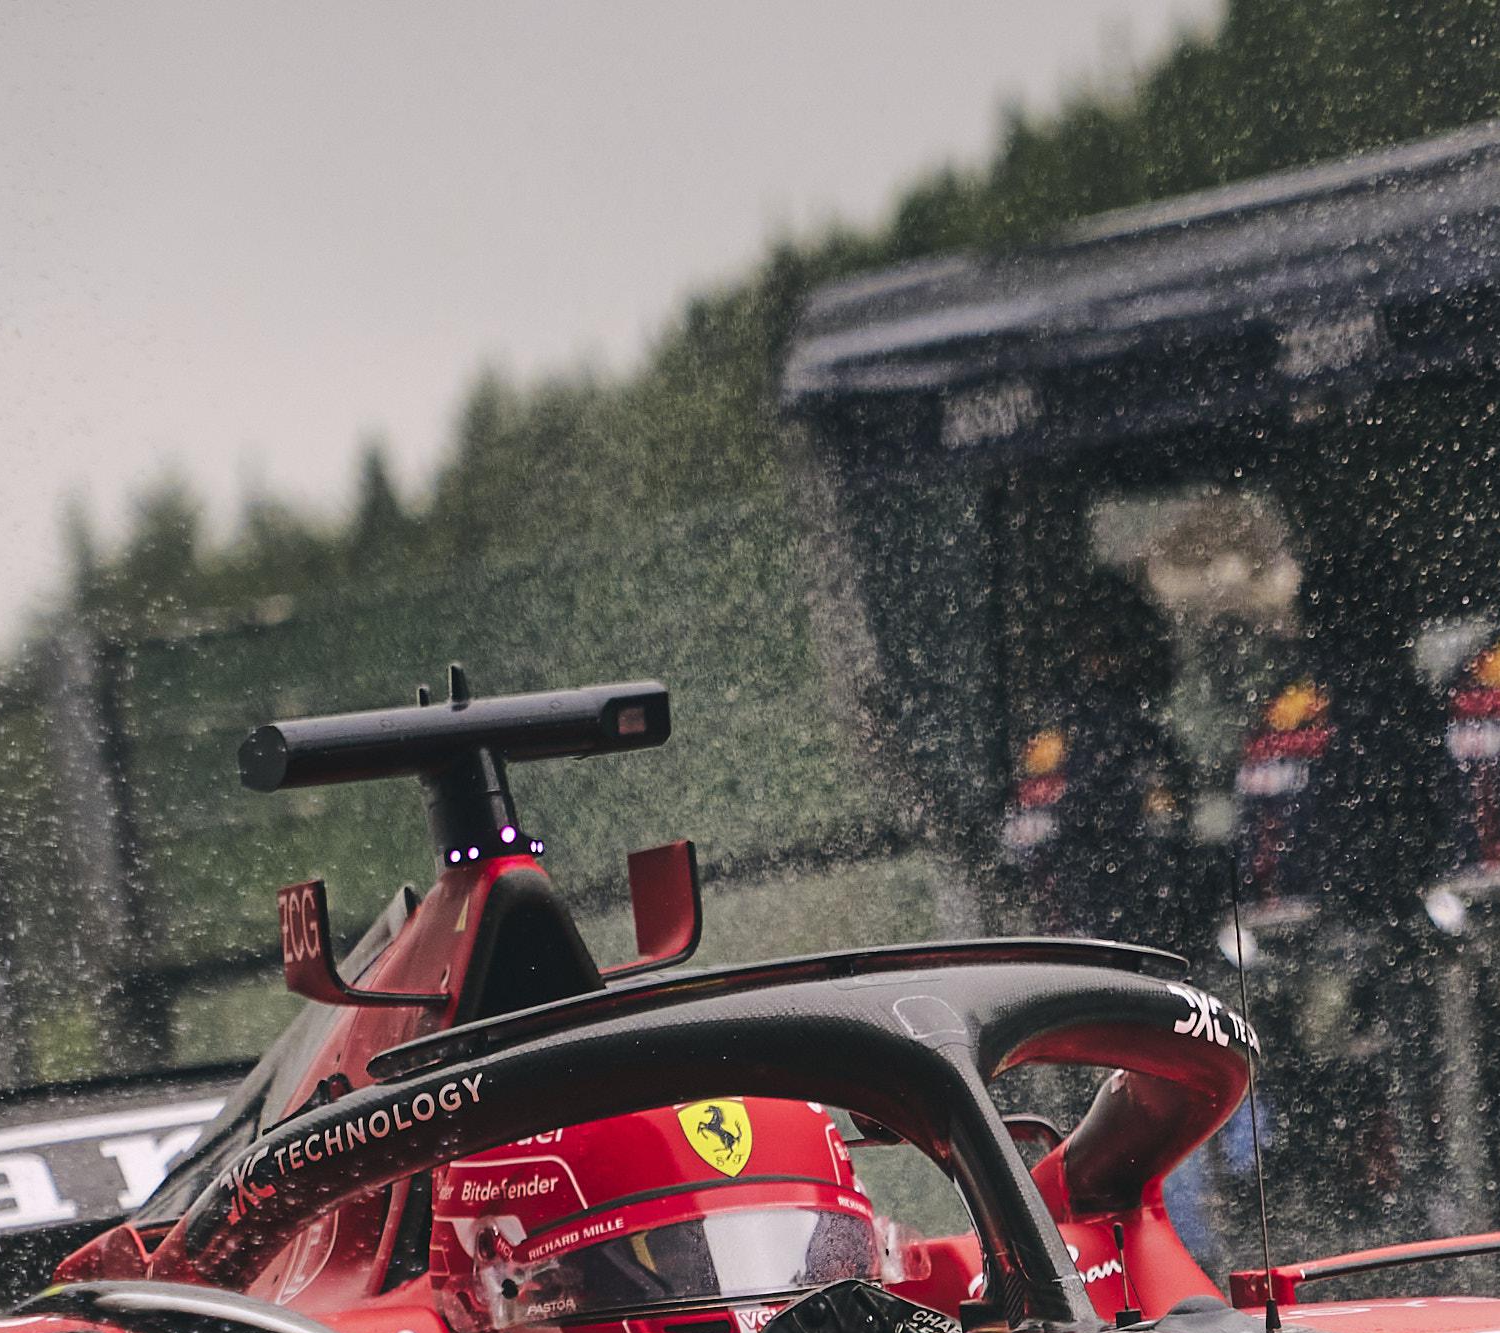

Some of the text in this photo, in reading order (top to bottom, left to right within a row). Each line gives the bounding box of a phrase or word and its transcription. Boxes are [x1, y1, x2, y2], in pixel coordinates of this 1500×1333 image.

[274, 1072, 484, 1176] TECHNOLOGY
[461, 1174, 559, 1202] Bitdefender
[528, 1217, 625, 1262] RICHARD MILLE
